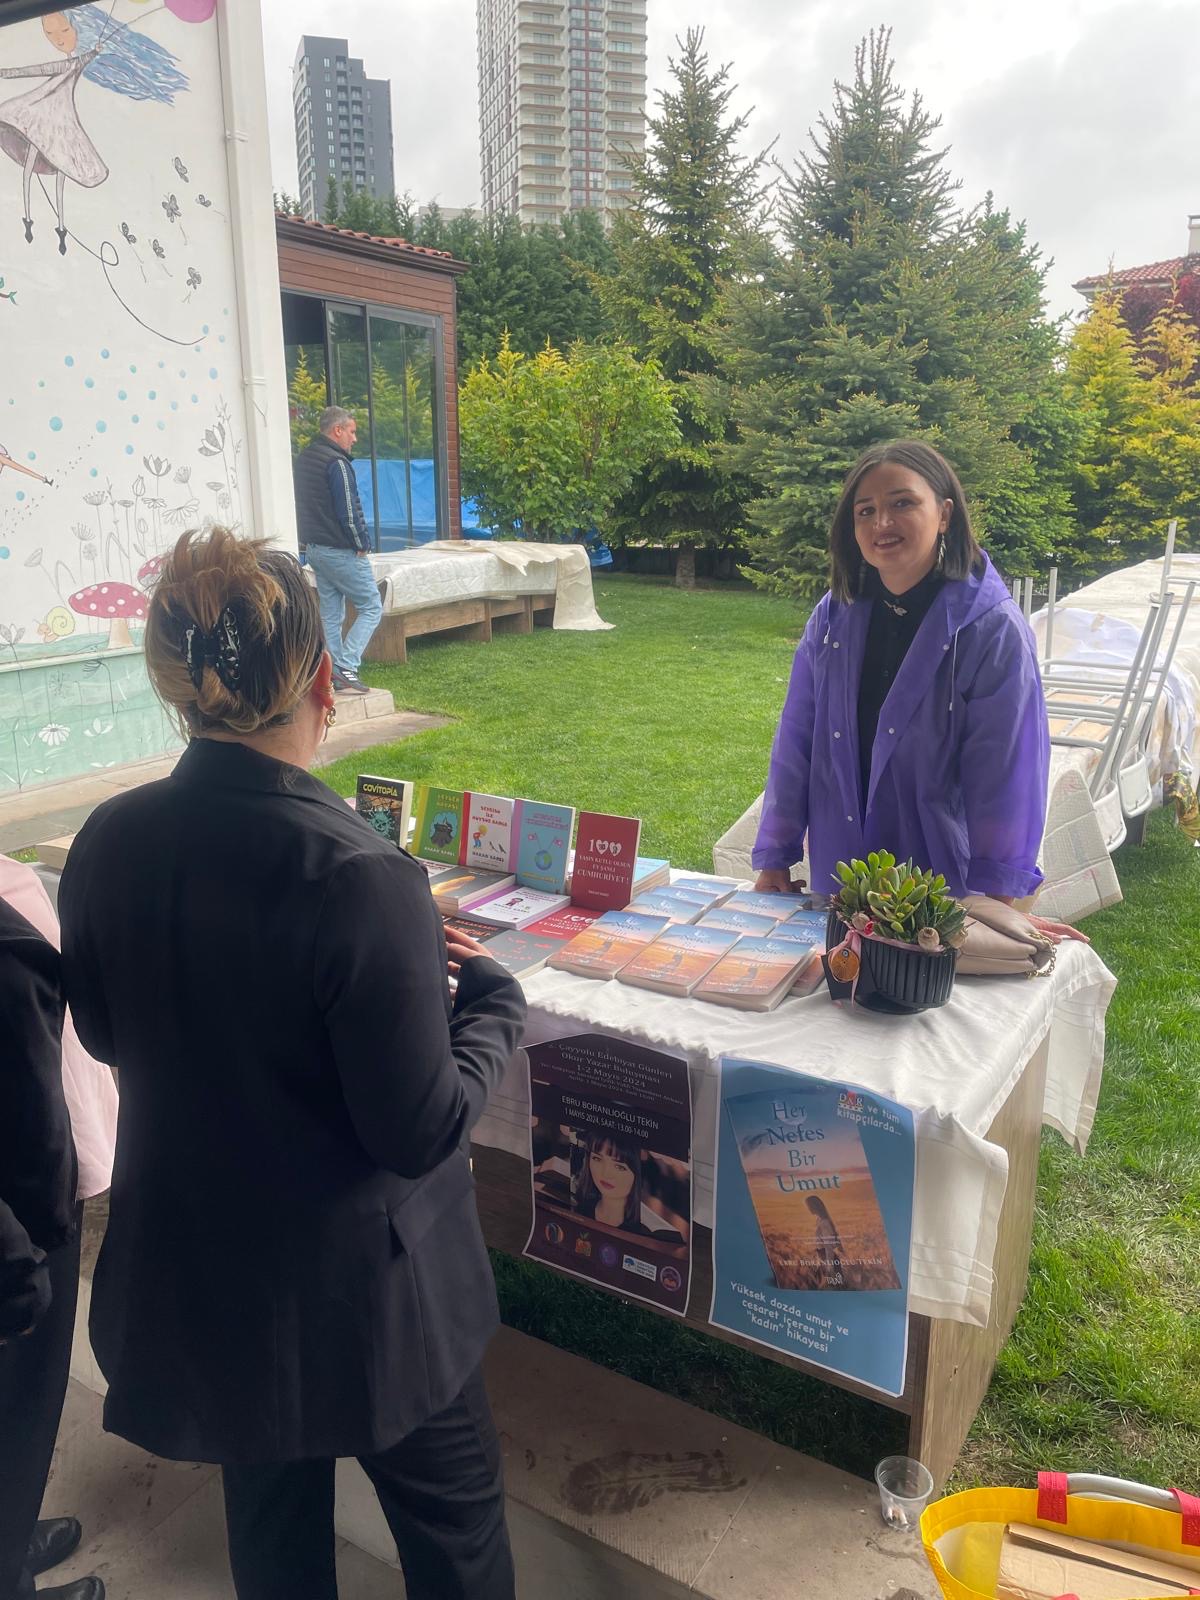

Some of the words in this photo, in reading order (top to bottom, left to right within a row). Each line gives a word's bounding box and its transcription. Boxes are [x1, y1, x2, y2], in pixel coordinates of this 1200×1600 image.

[561, 1052, 584, 1065] Okur
[586, 1056, 612, 1070] Yazar
[597, 1050, 637, 1069] Edebiyat
[638, 1063, 673, 1079] Günleri
[593, 1067, 621, 1082] Mayıs
[622, 1078, 646, 1088] 2024
[561, 1095, 581, 1108] EBRU
[582, 1100, 636, 1123] BORANLIOĞLU
[771, 1101, 806, 1120] Her
[867, 1105, 879, 1114] ve
[883, 1109, 900, 1124] tüm
[765, 1124, 825, 1145] Nefes
[788, 1150, 817, 1168] Bir
[776, 1174, 841, 1193] Umut
[730, 1281, 766, 1303] Yüksek
[770, 1297, 802, 1317] dozda
[805, 1313, 833, 1329] umut
[836, 1324, 849, 1336] ve
[742, 1300, 780, 1320] cesaret
[783, 1314, 815, 1335] içeren
[820, 1330, 836, 1342] bir
[786, 1326, 828, 1353] hikayesi
